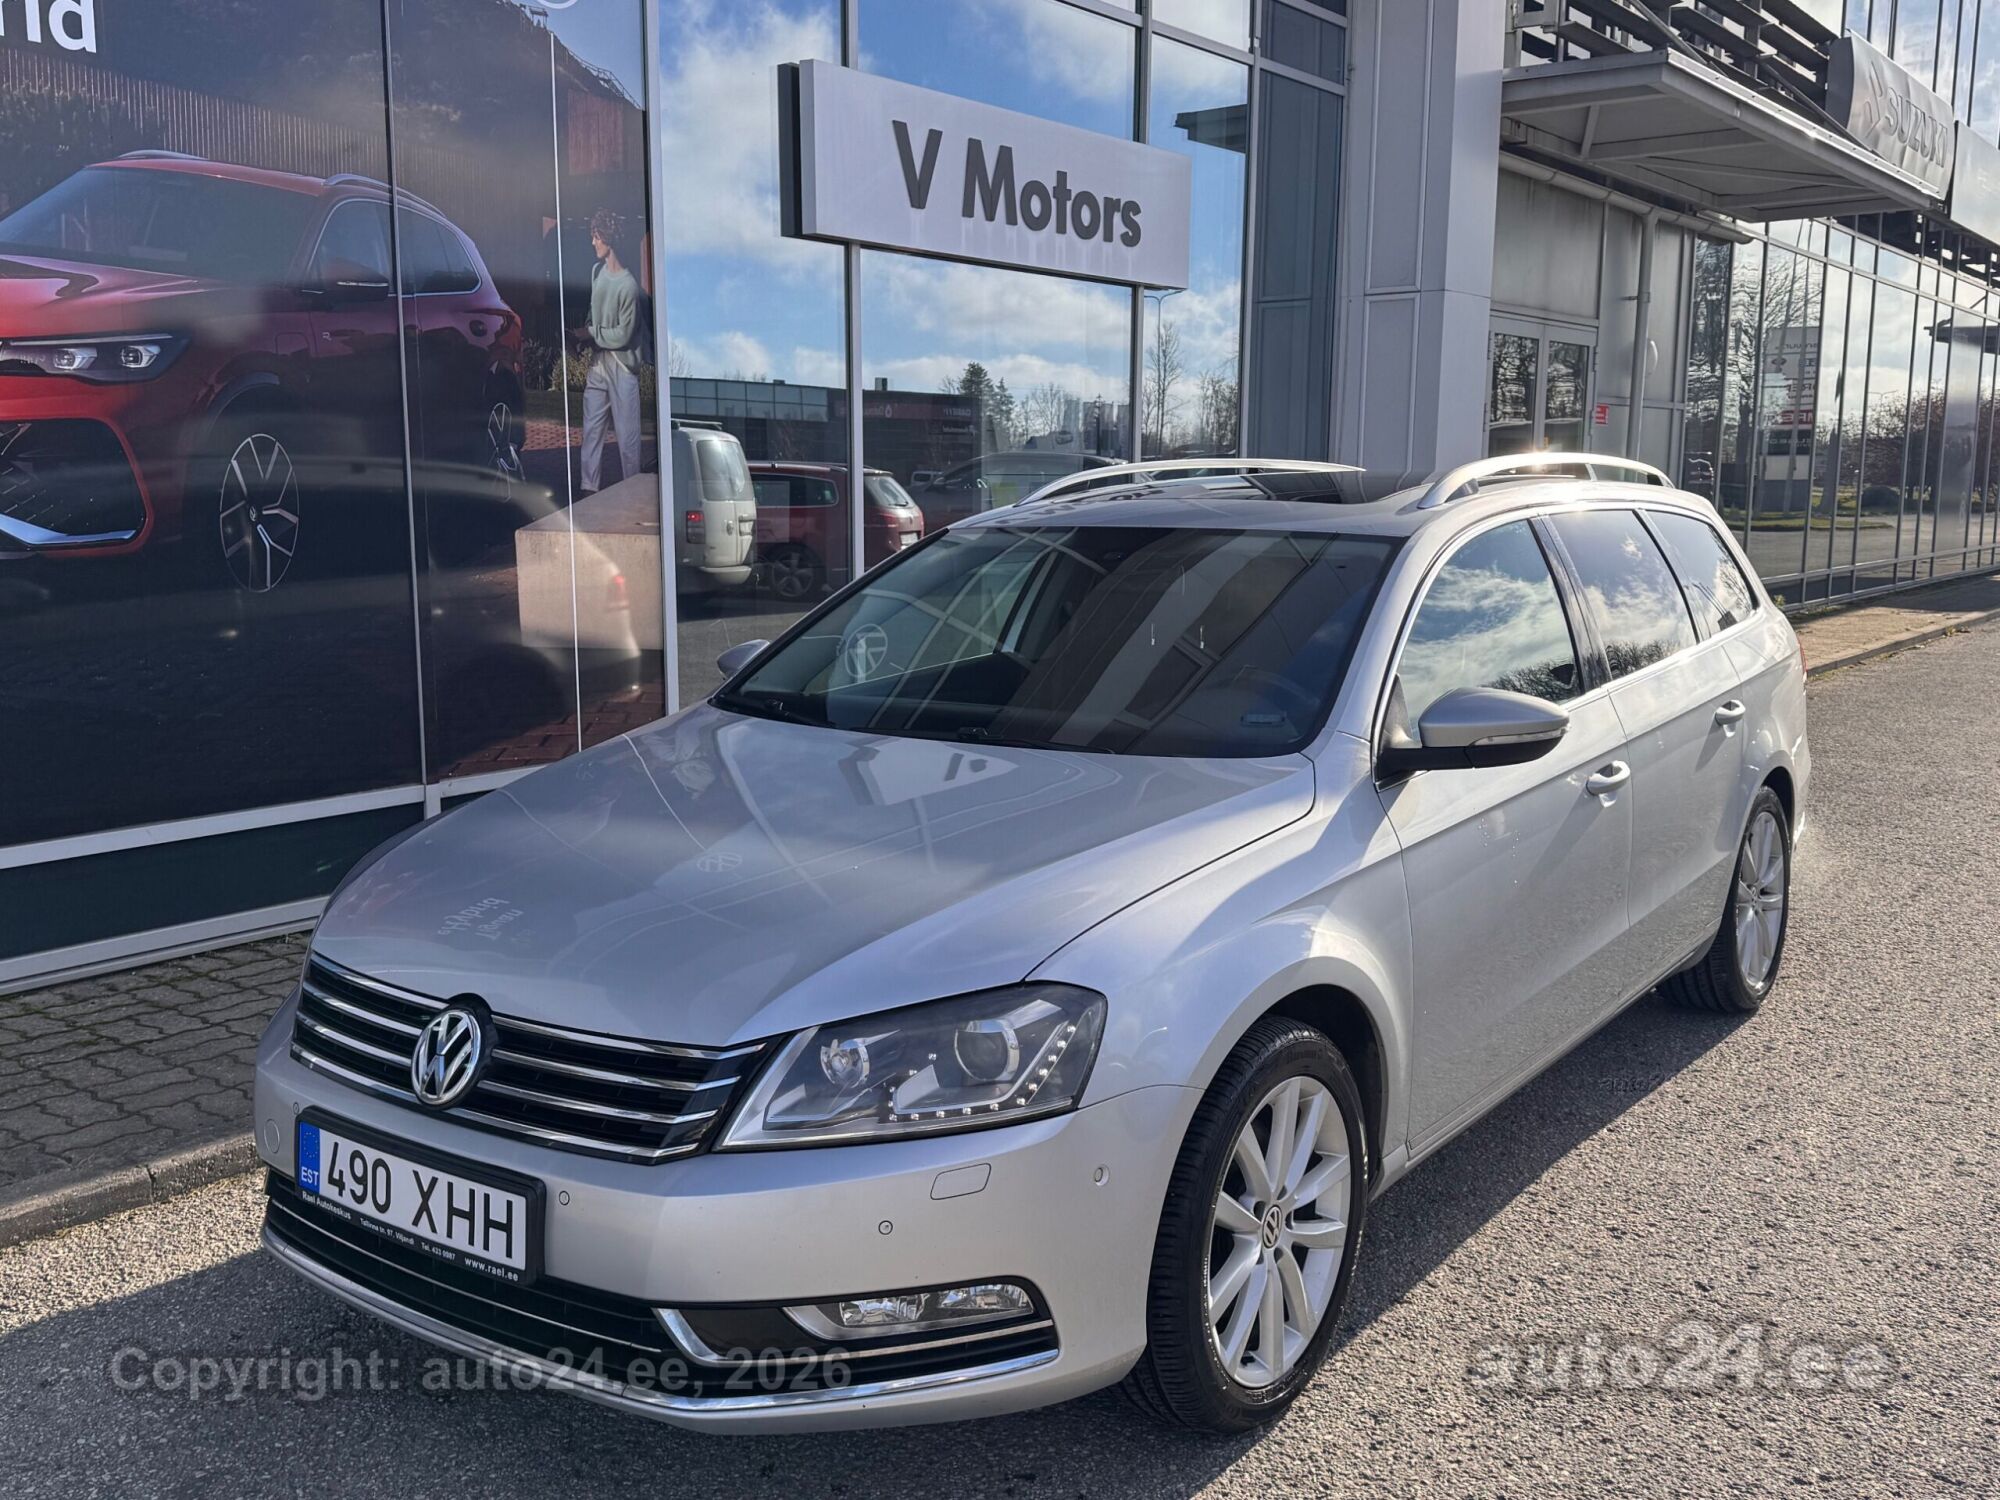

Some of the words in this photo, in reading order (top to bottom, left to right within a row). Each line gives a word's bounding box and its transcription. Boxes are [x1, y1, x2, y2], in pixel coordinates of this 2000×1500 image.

[0, 0, 97, 53] id
[1884, 86, 1948, 168] SUZUKI
[892, 119, 943, 209] V
[962, 137, 1142, 248] Motors
[301, 1166, 319, 1187] EST
[327, 1141, 392, 1214] 490
[411, 1169, 514, 1260] XHH
[464, 1256, 519, 1282] www.rael.ee
